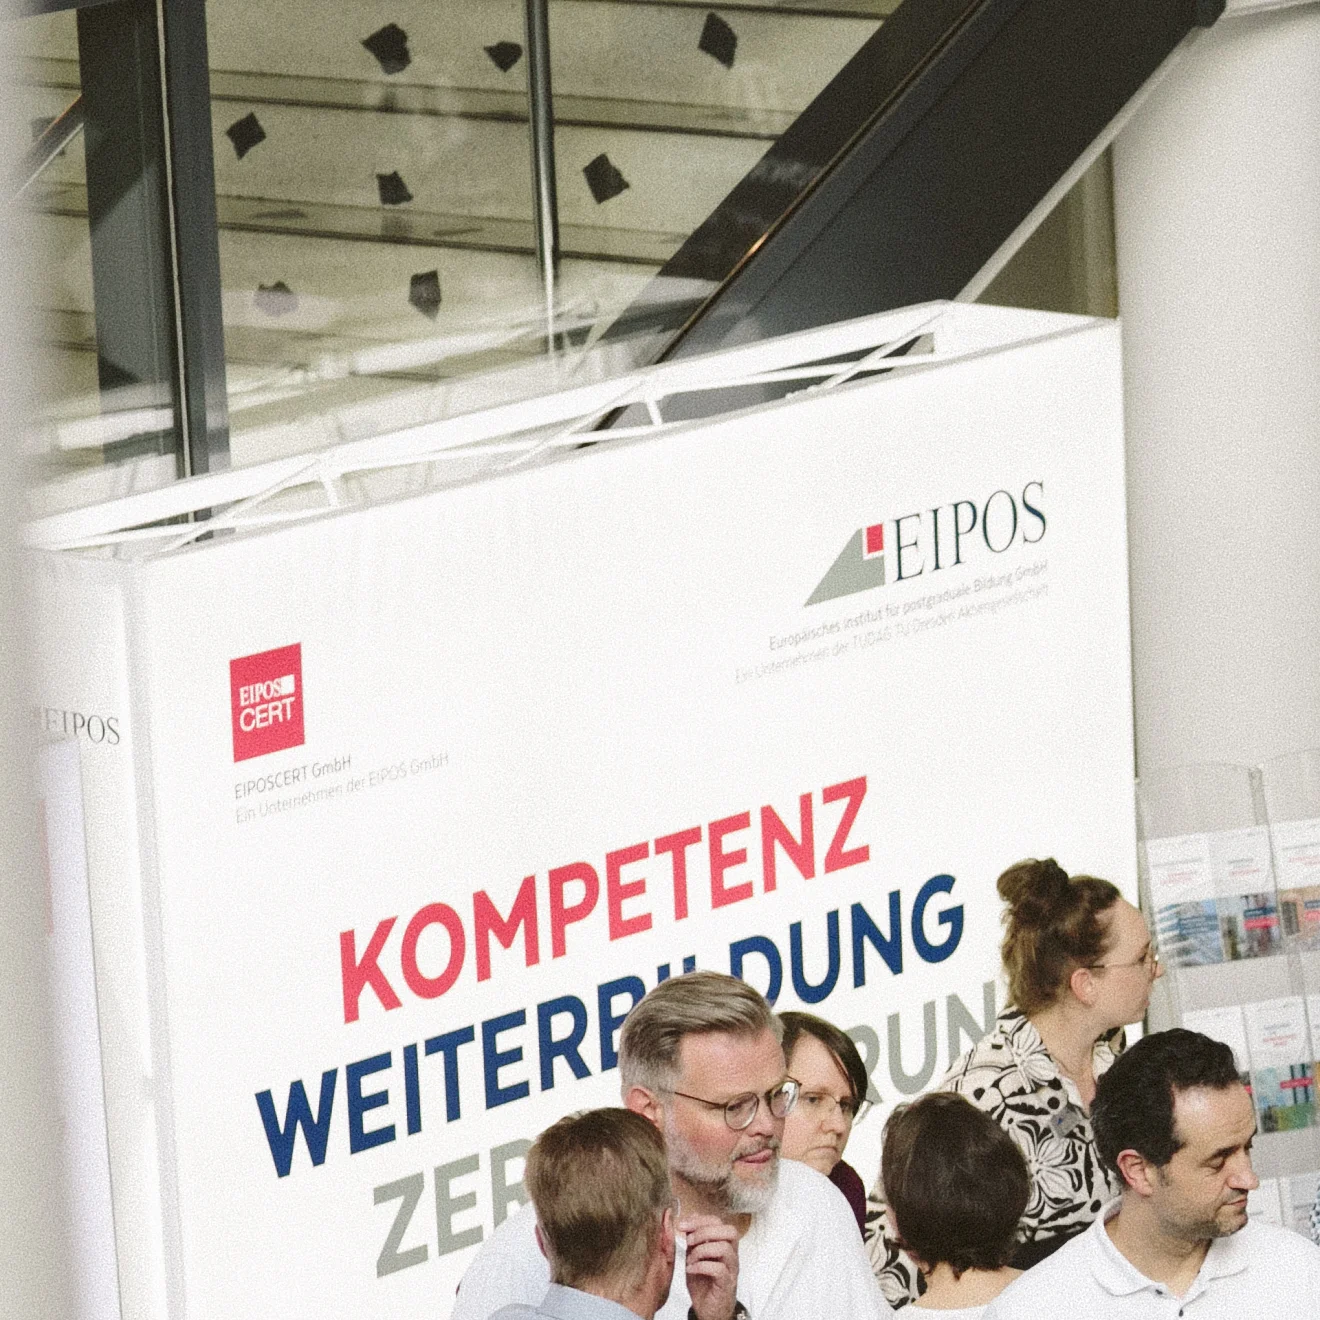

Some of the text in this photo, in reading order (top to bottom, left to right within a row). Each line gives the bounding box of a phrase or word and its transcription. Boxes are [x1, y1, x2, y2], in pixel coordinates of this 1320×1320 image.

[891, 480, 1047, 582] EIPOS
[239, 677, 282, 707] EIPOS
[239, 696, 296, 732] CERT
[45, 708, 120, 746] EIPOS
[234, 754, 351, 800] EIPOSCERT GmbH
[236, 751, 449, 824] Ein Unternehmen der EIPOS GmbH
[339, 775, 870, 1025] KOMPETENZ
[255, 873, 964, 1179] WEITERBDUNG
